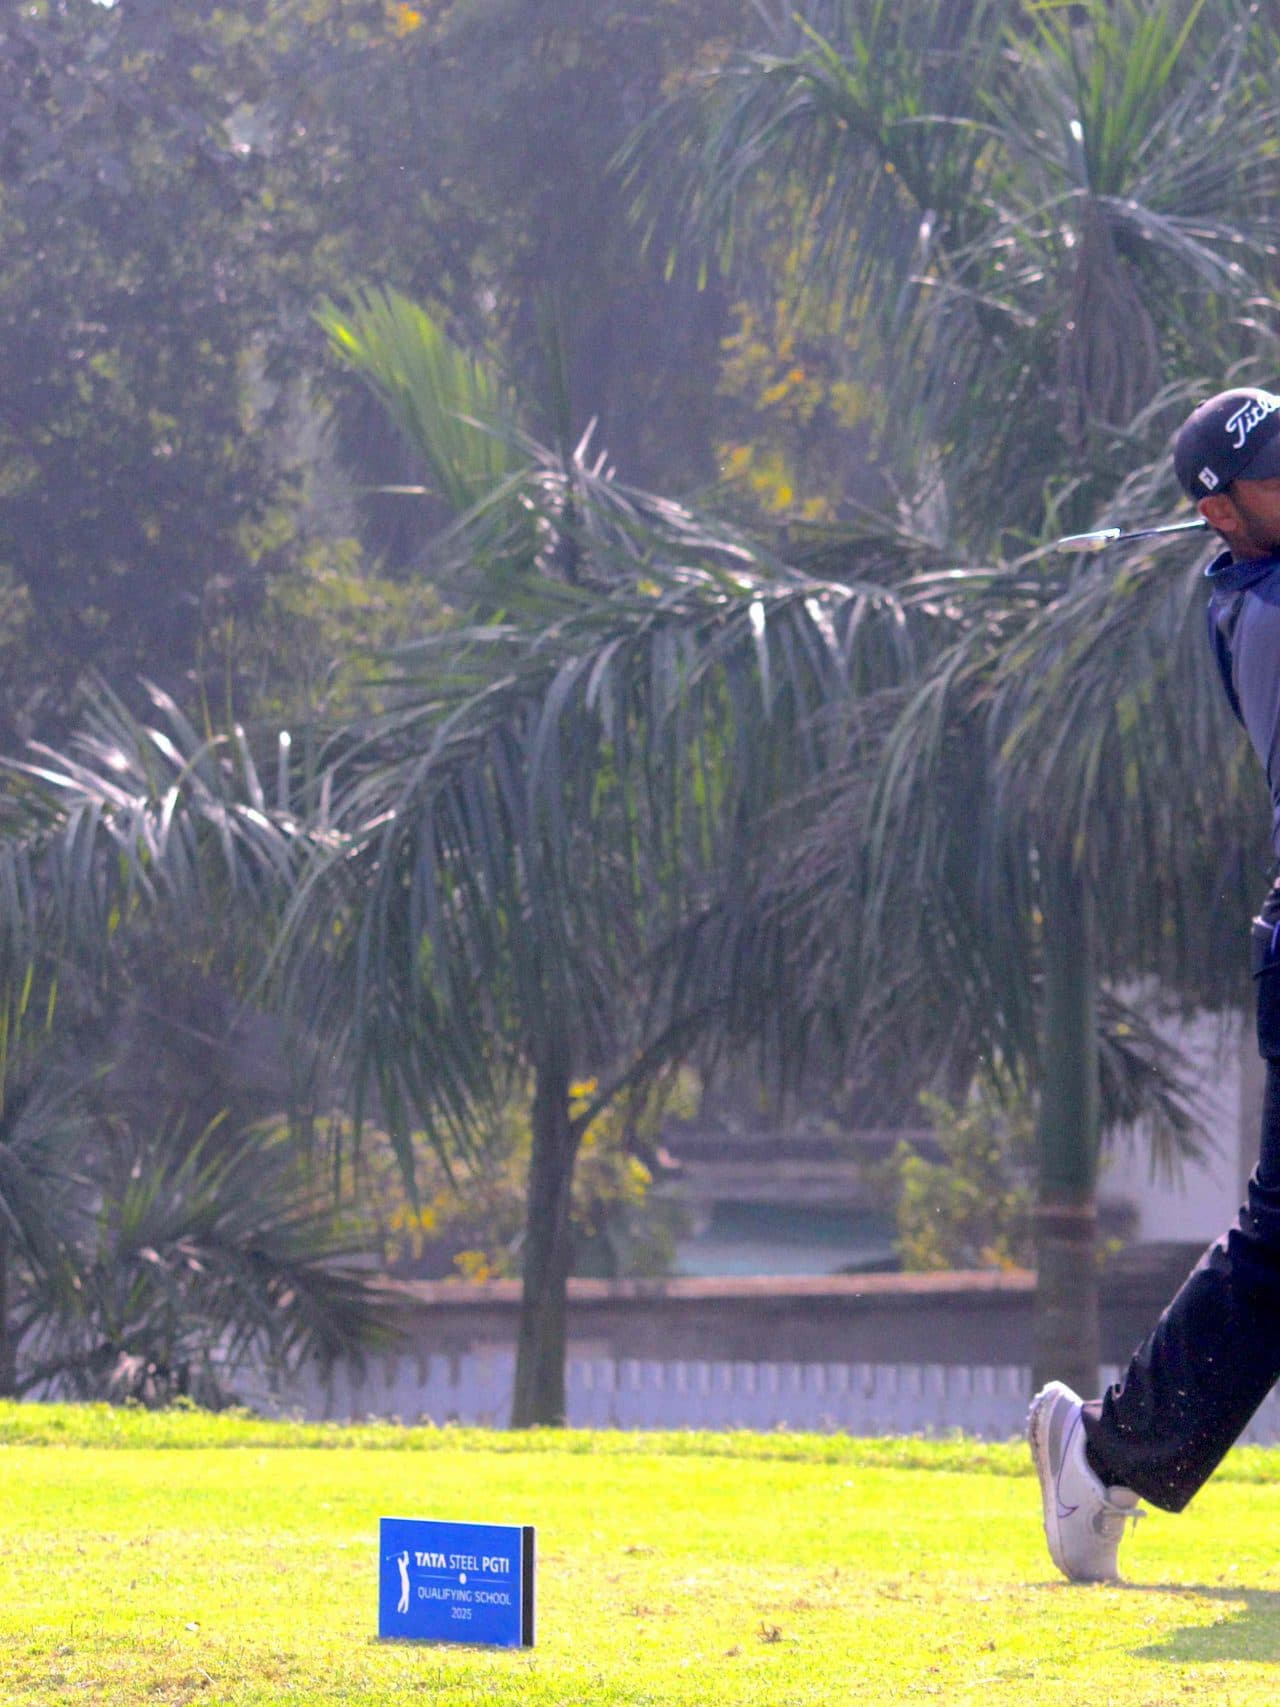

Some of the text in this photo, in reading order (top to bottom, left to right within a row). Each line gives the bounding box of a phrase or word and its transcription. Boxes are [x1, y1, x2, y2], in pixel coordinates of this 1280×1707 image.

[415, 1552, 509, 1573] TATA STEEL PGTI
[417, 1586, 512, 1605] QUALIFYING SCHOOL
[451, 1607, 473, 1620] 2025
